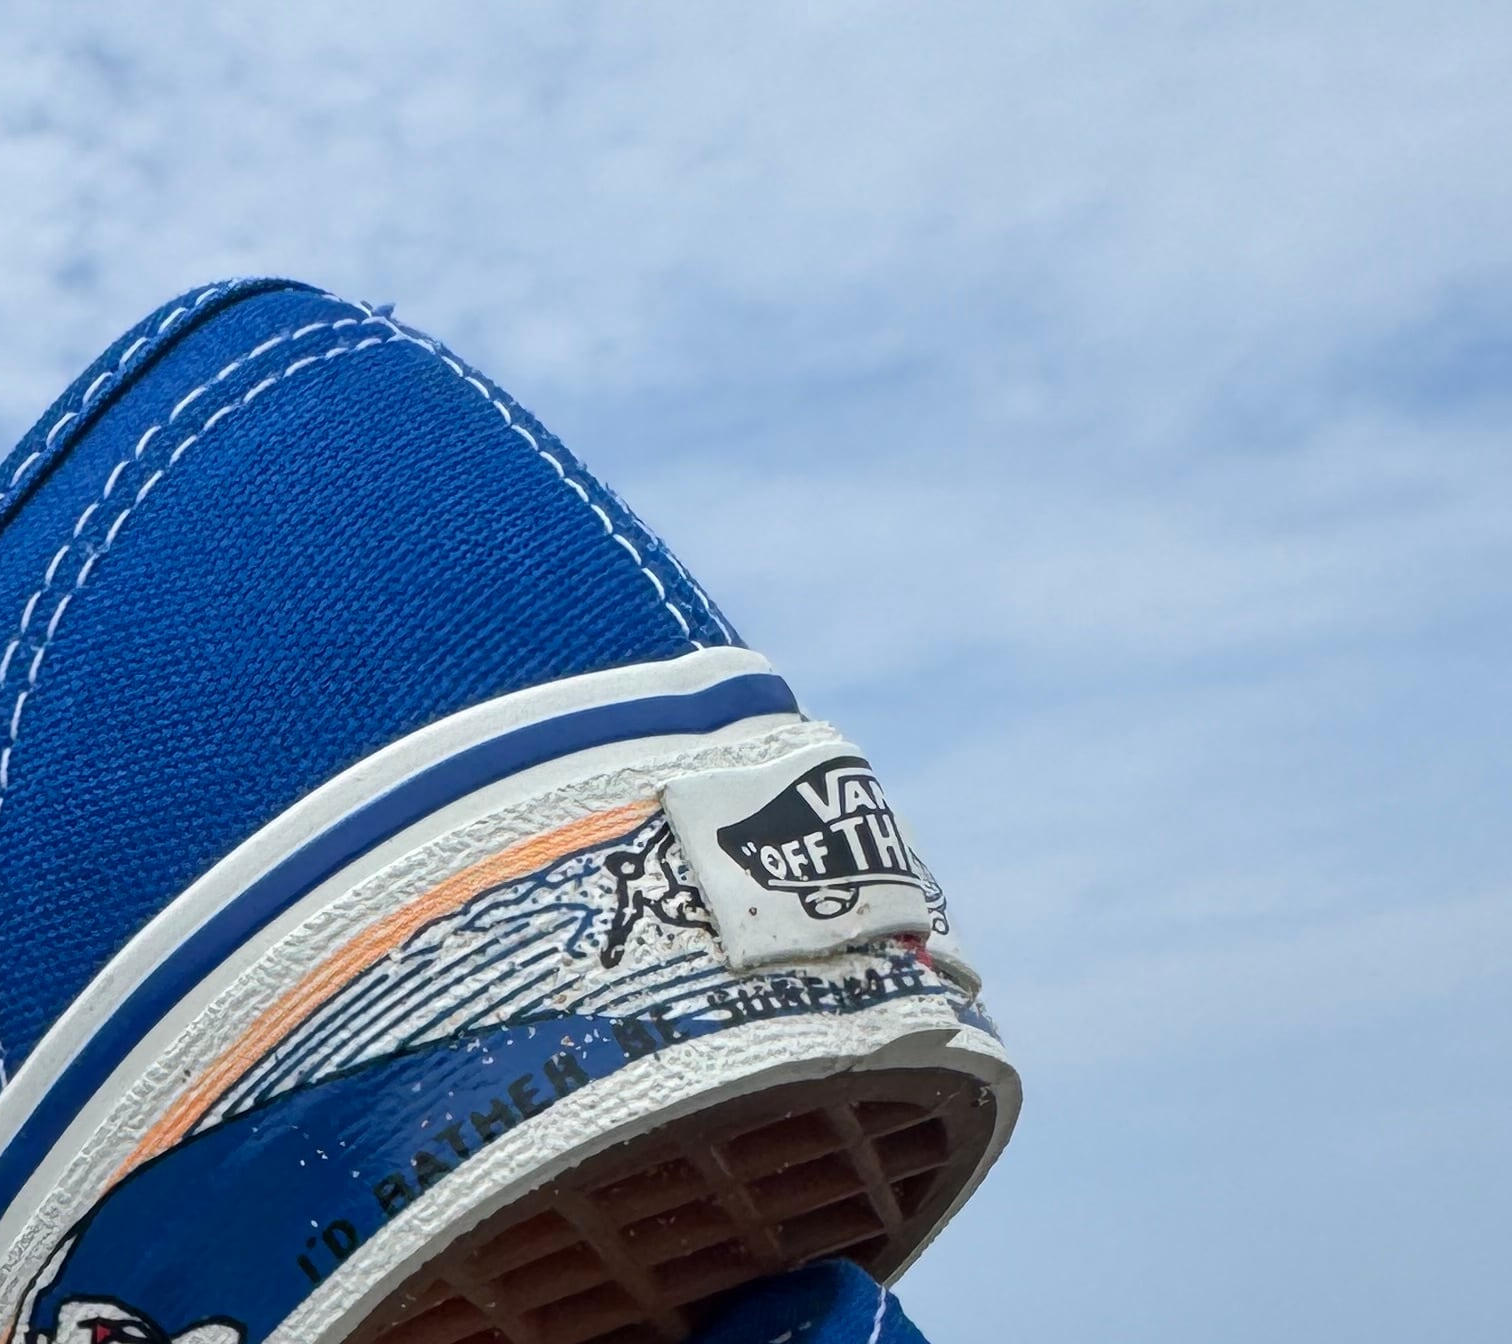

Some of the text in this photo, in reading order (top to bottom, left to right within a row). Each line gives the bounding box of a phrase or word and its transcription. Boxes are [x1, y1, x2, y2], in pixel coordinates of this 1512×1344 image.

[296, 1218, 360, 1285] I'D
[372, 1052, 590, 1216] RATHER
[612, 1003, 684, 1057] BE
